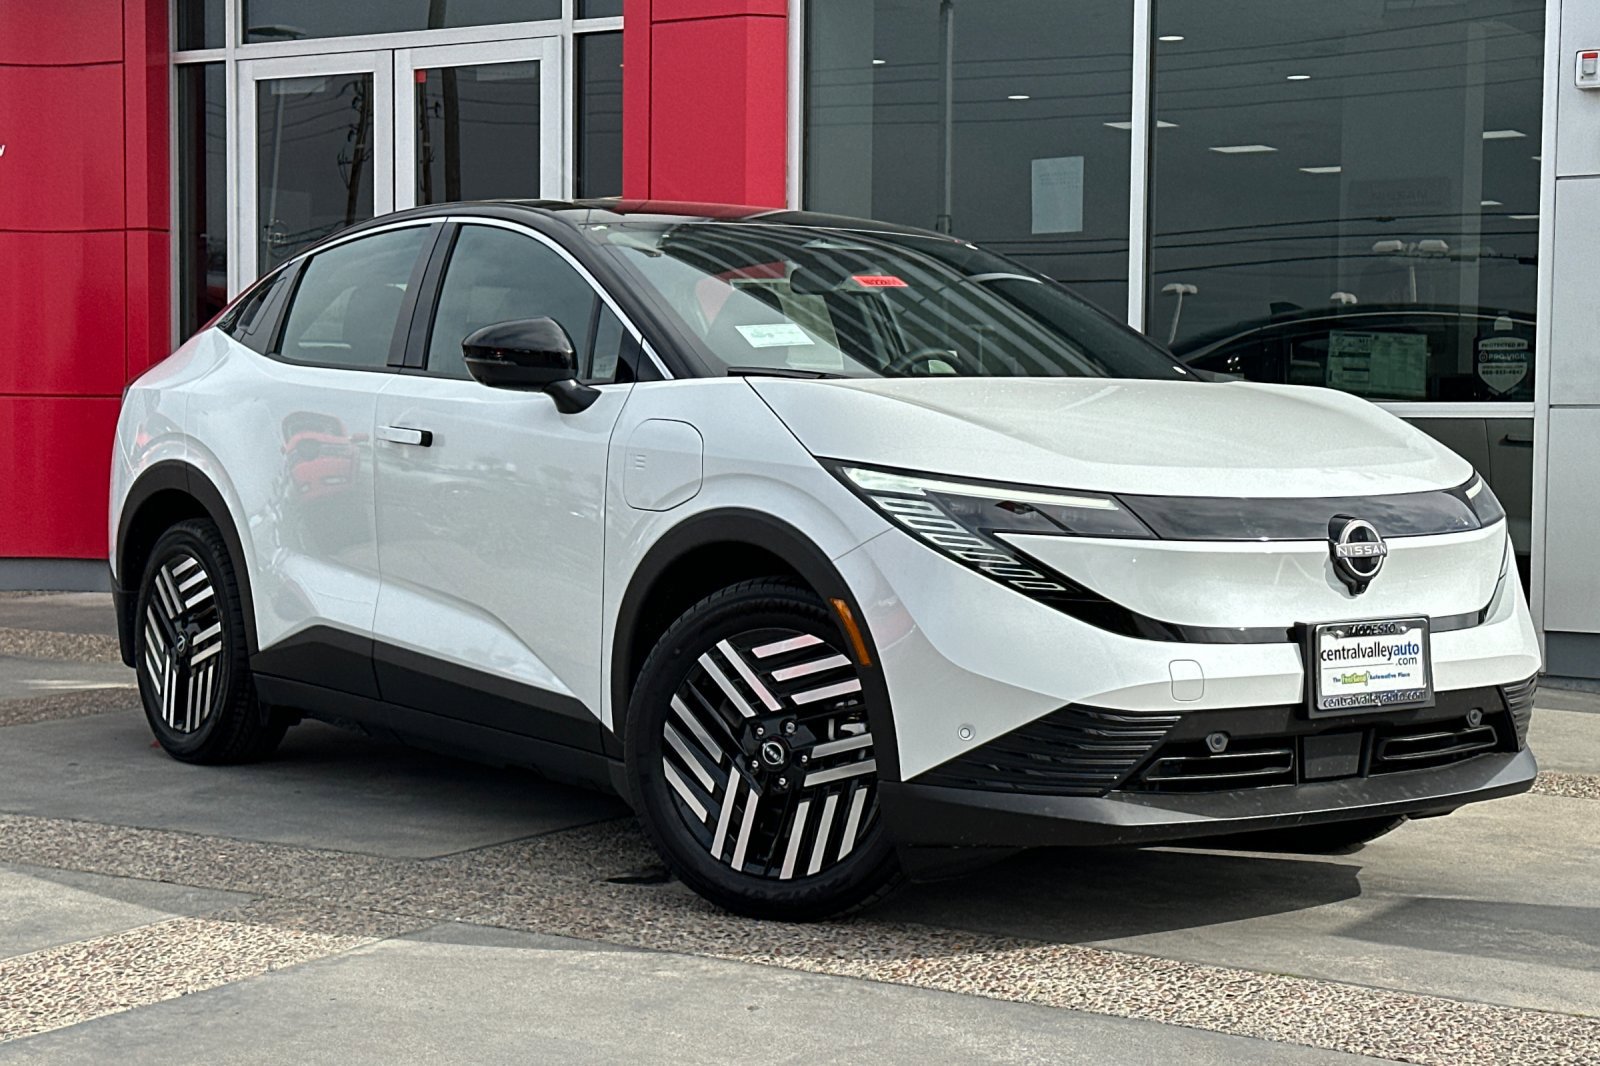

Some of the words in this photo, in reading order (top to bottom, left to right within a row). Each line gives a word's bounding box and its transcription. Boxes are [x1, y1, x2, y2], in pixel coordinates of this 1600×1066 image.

[1337, 544, 1387, 557] NISSAN
[1320, 641, 1419, 661] centralvalleyauto
[1323, 690, 1427, 708] centralvalleyauto.com
